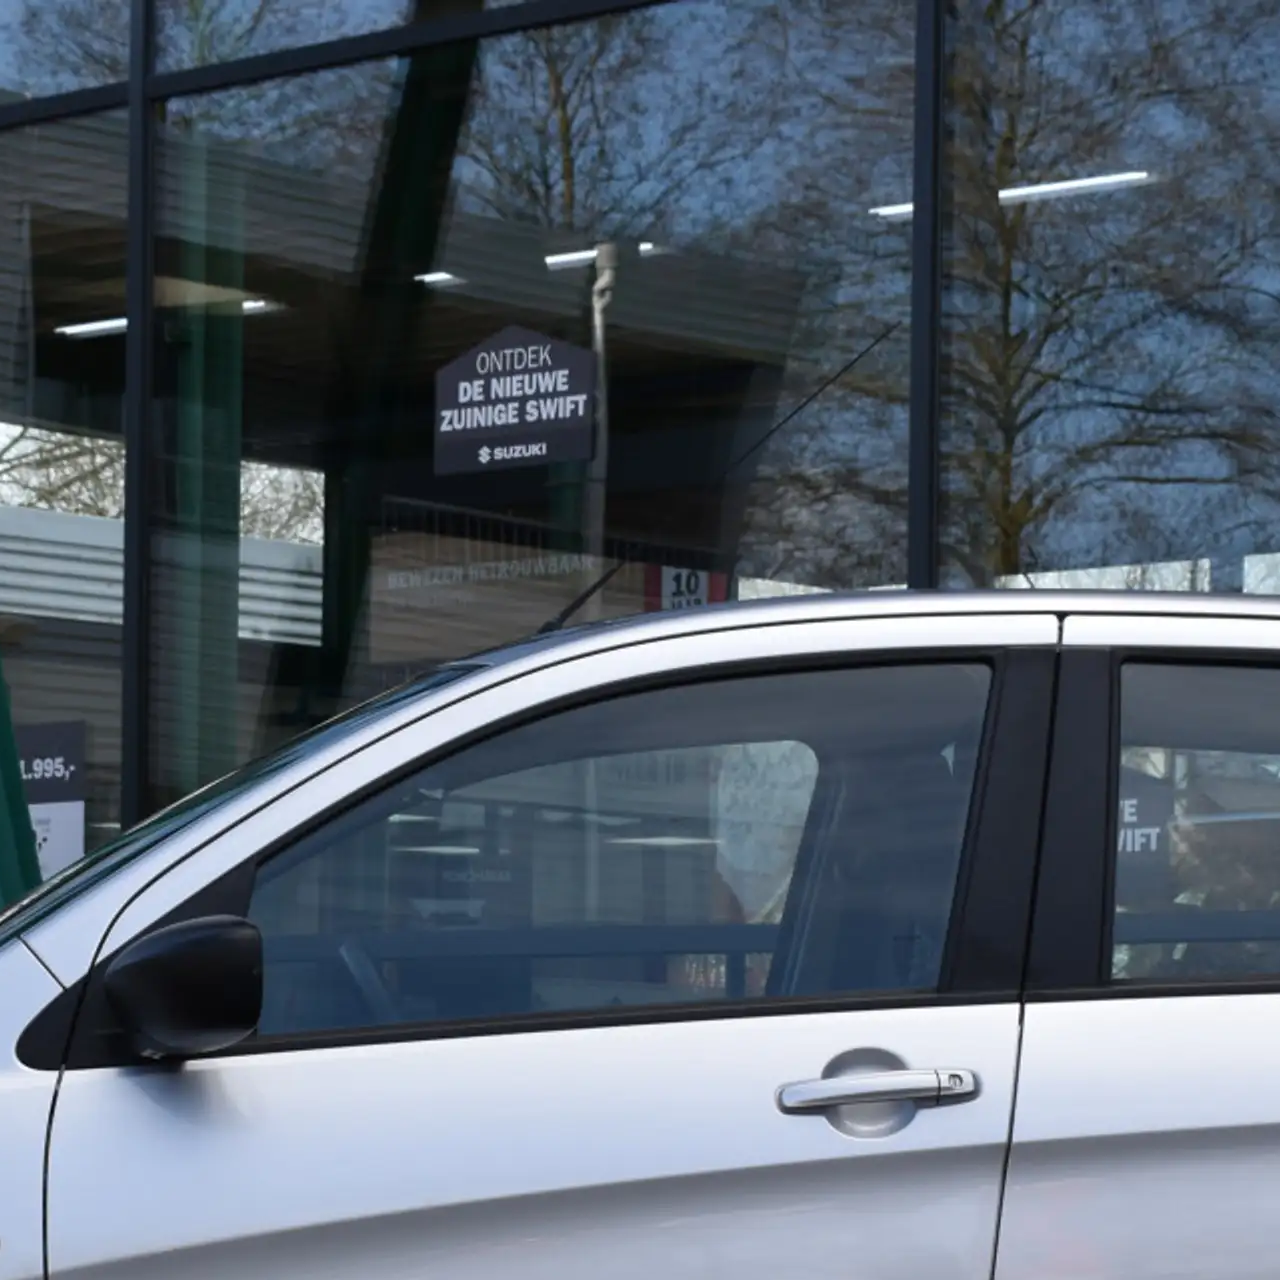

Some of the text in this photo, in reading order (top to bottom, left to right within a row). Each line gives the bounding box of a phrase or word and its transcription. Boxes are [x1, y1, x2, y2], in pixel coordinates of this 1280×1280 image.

[476, 344, 552, 375] ONTDEK
[457, 369, 570, 403] DE NIEUWE
[439, 394, 588, 432] ZUINIGE SWIFT
[493, 442, 548, 461] SUZUKI
[671, 571, 701, 597] 10
[1120, 799, 1138, 823] E
